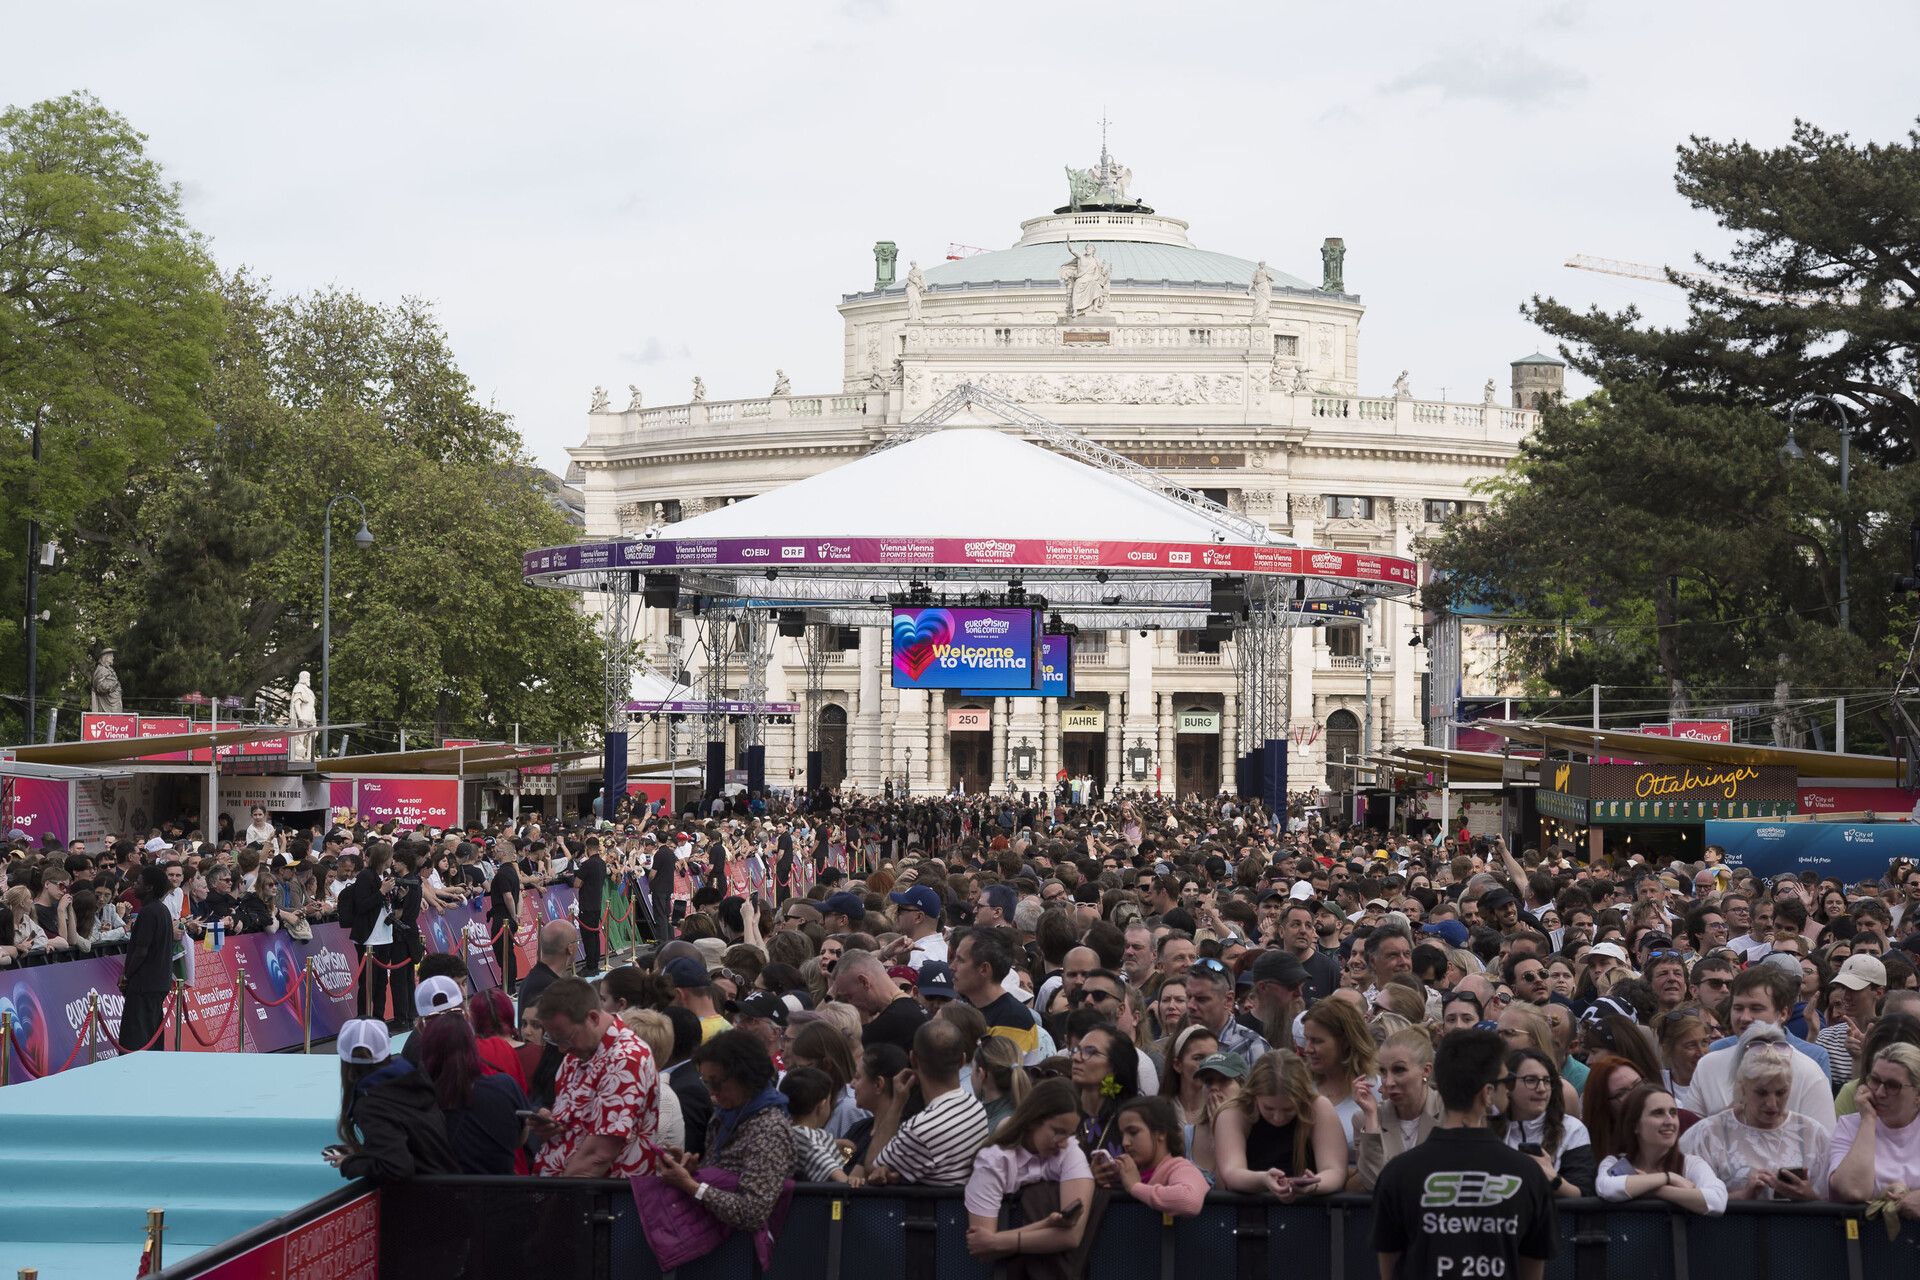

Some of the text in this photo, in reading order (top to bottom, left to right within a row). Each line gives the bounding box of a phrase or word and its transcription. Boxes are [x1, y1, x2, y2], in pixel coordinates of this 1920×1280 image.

[676, 545, 717, 553] Vienna Vienna
[783, 548, 804, 557] ORF
[830, 546, 842, 554] City
[880, 544, 934, 552] Vienna Vienna
[1046, 545, 1099, 554] Vienna Vienna
[755, 549, 770, 557] EBU
[1142, 552, 1157, 560] EBU
[1170, 553, 1190, 562] ORF
[1213, 553, 1225, 561] City
[1254, 553, 1292, 562] Vienna Vienna
[932, 644, 1015, 658] Welcome
[940, 655, 1027, 669] to Vienna
[959, 715, 979, 726] 250
[1067, 716, 1098, 727] JAHRE
[1184, 717, 1212, 728] BURG
[105, 724, 118, 734] City
[1696, 733, 1711, 741] City
[1636, 766, 1759, 798] Ottakringer
[394, 807, 401, 815] A
[403, 806, 420, 817] Life
[428, 807, 447, 815] Get
[1855, 831, 1866, 839] City
[194, 987, 233, 1005] Vienna Vienna
[1423, 1213, 1519, 1236] Steward
[1437, 1255, 1506, 1278] P 260
